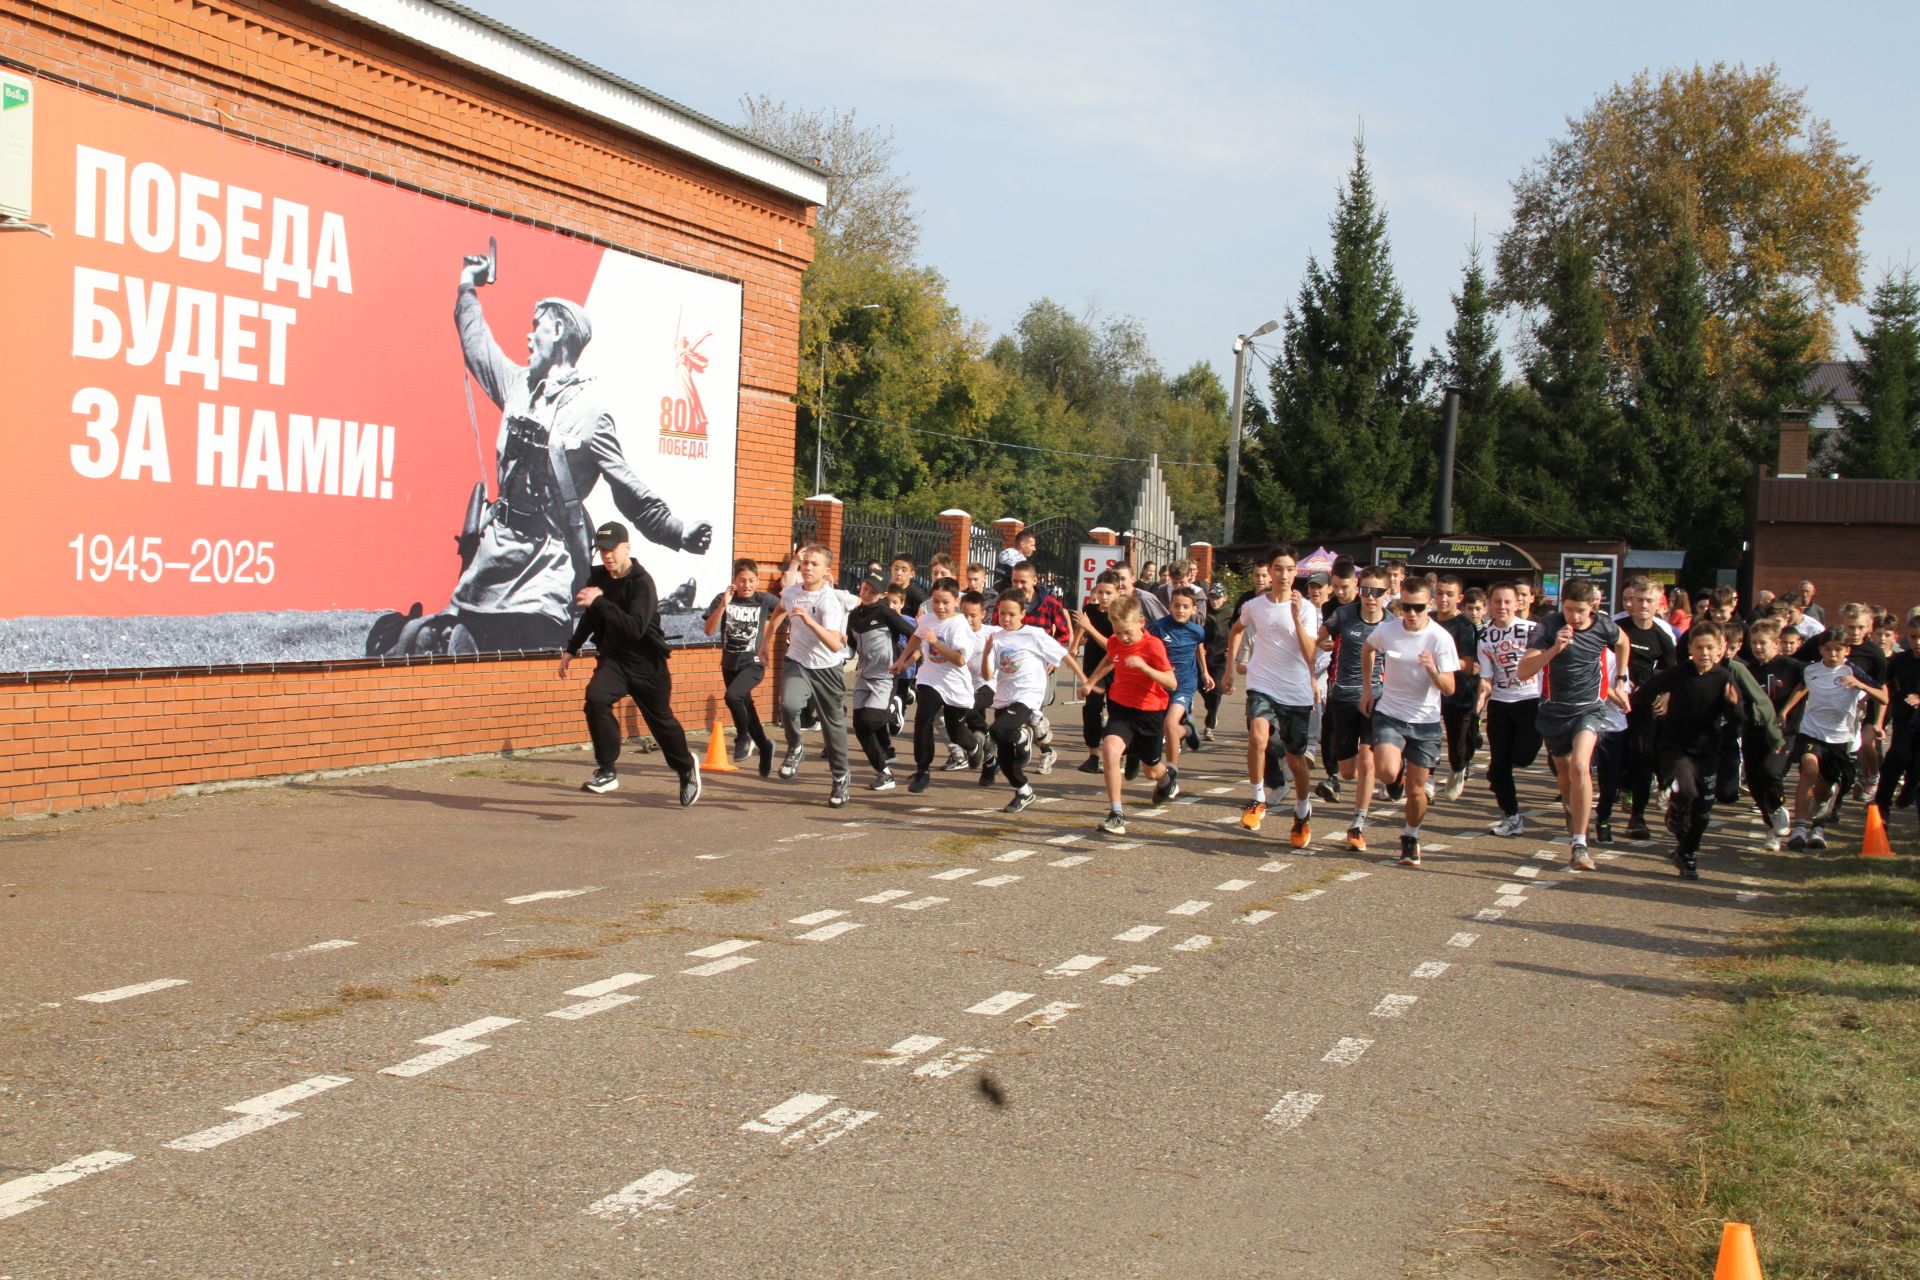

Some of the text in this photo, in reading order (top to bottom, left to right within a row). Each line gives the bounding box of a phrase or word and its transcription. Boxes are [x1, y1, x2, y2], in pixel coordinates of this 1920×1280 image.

[75, 144, 353, 299] ПОБЕДА
[72, 265, 297, 391] БУДЕТ
[659, 396, 688, 432] 80
[70, 386, 396, 499] ЗА НАМИ!
[658, 437, 709, 461] ПОБЕДА!
[1426, 554, 1513, 567] Место встречи
[1450, 543, 1489, 555] Шаурма
